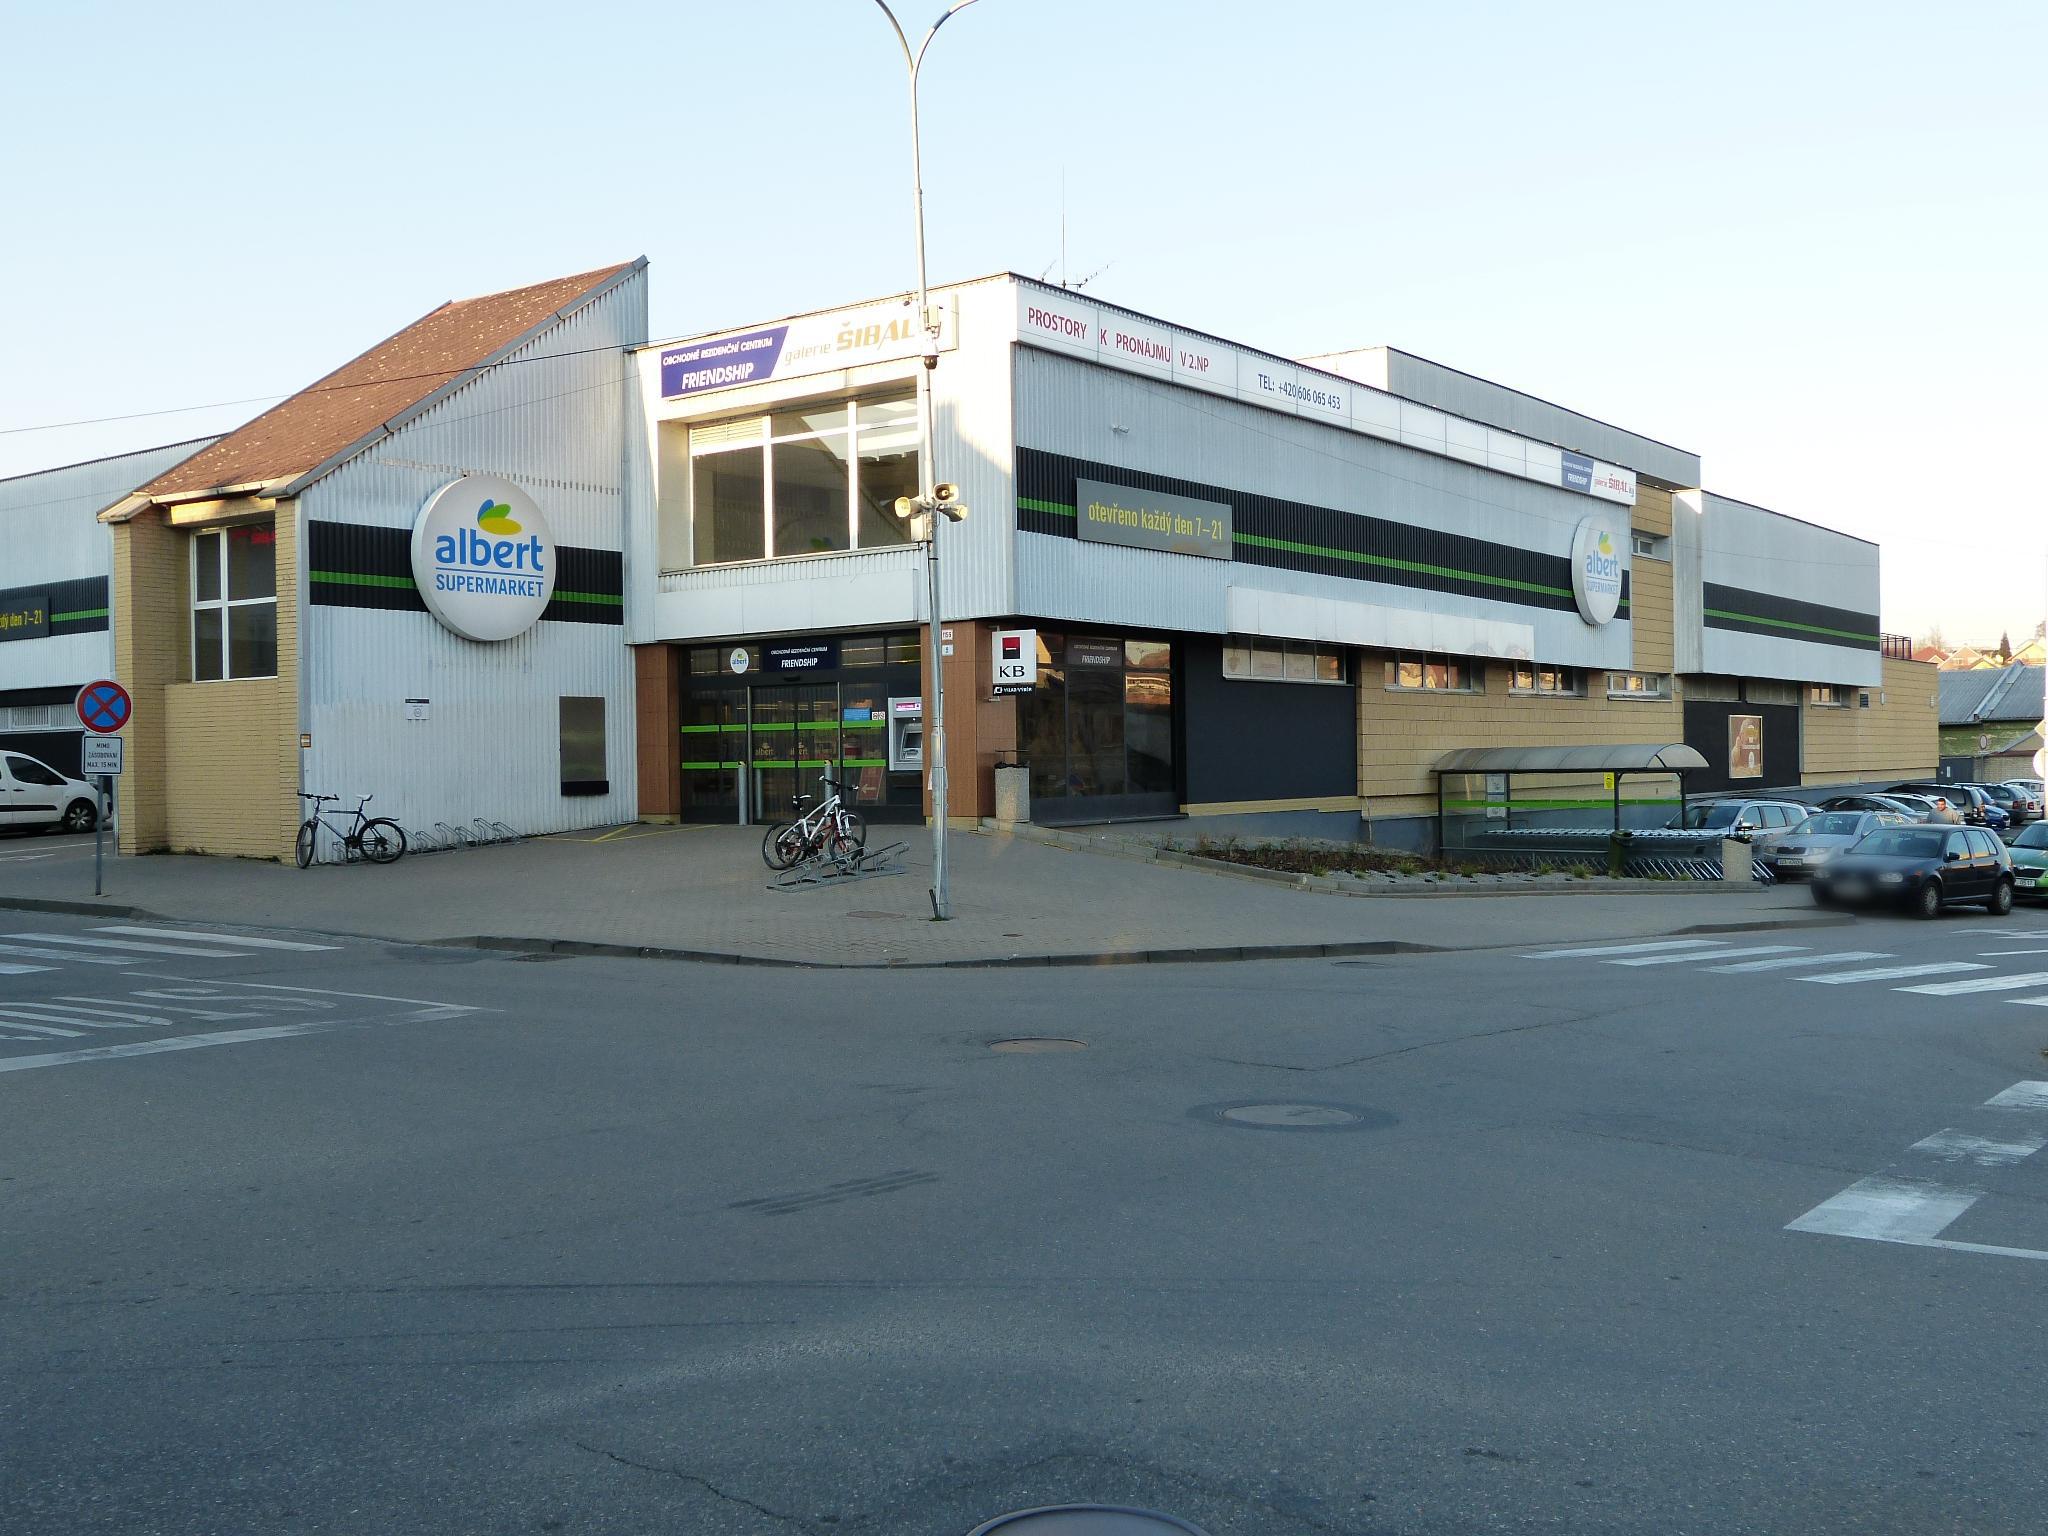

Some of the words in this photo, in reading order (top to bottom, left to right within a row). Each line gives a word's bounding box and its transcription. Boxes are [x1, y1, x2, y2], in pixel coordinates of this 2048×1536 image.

[740, 336, 773, 352] CENTRUM
[784, 343, 831, 367] galerie
[836, 320, 916, 351] ŠIBAL
[1028, 306, 1087, 340] PROSTORY
[1100, 328, 1108, 346] K
[1116, 333, 1171, 363] PRONÁJMU
[1180, 351, 1187, 367] V
[1189, 354, 1209, 372] 2.NP
[681, 362, 755, 390] FRIENDSHIP
[1258, 373, 1275, 392] TEL:
[1278, 381, 1297, 398] +420
[1297, 386, 1311, 402] 606
[1312, 390, 1326, 406] 065
[1327, 394, 1341, 410] 453
[1088, 501, 1138, 528] otevřeno
[1141, 508, 1171, 537] každý
[1174, 514, 1193, 536] den
[435, 527, 544, 572] albert
[1586, 550, 1618, 577] albert
[436, 573, 544, 598] SUPERMARKET
[1586, 580, 1618, 596] SUPERMARKET
[10, 612, 22, 627] den
[732, 657, 747, 666] albert
[781, 657, 818, 668] FRIENDSHIP
[999, 665, 1026, 678] KB
